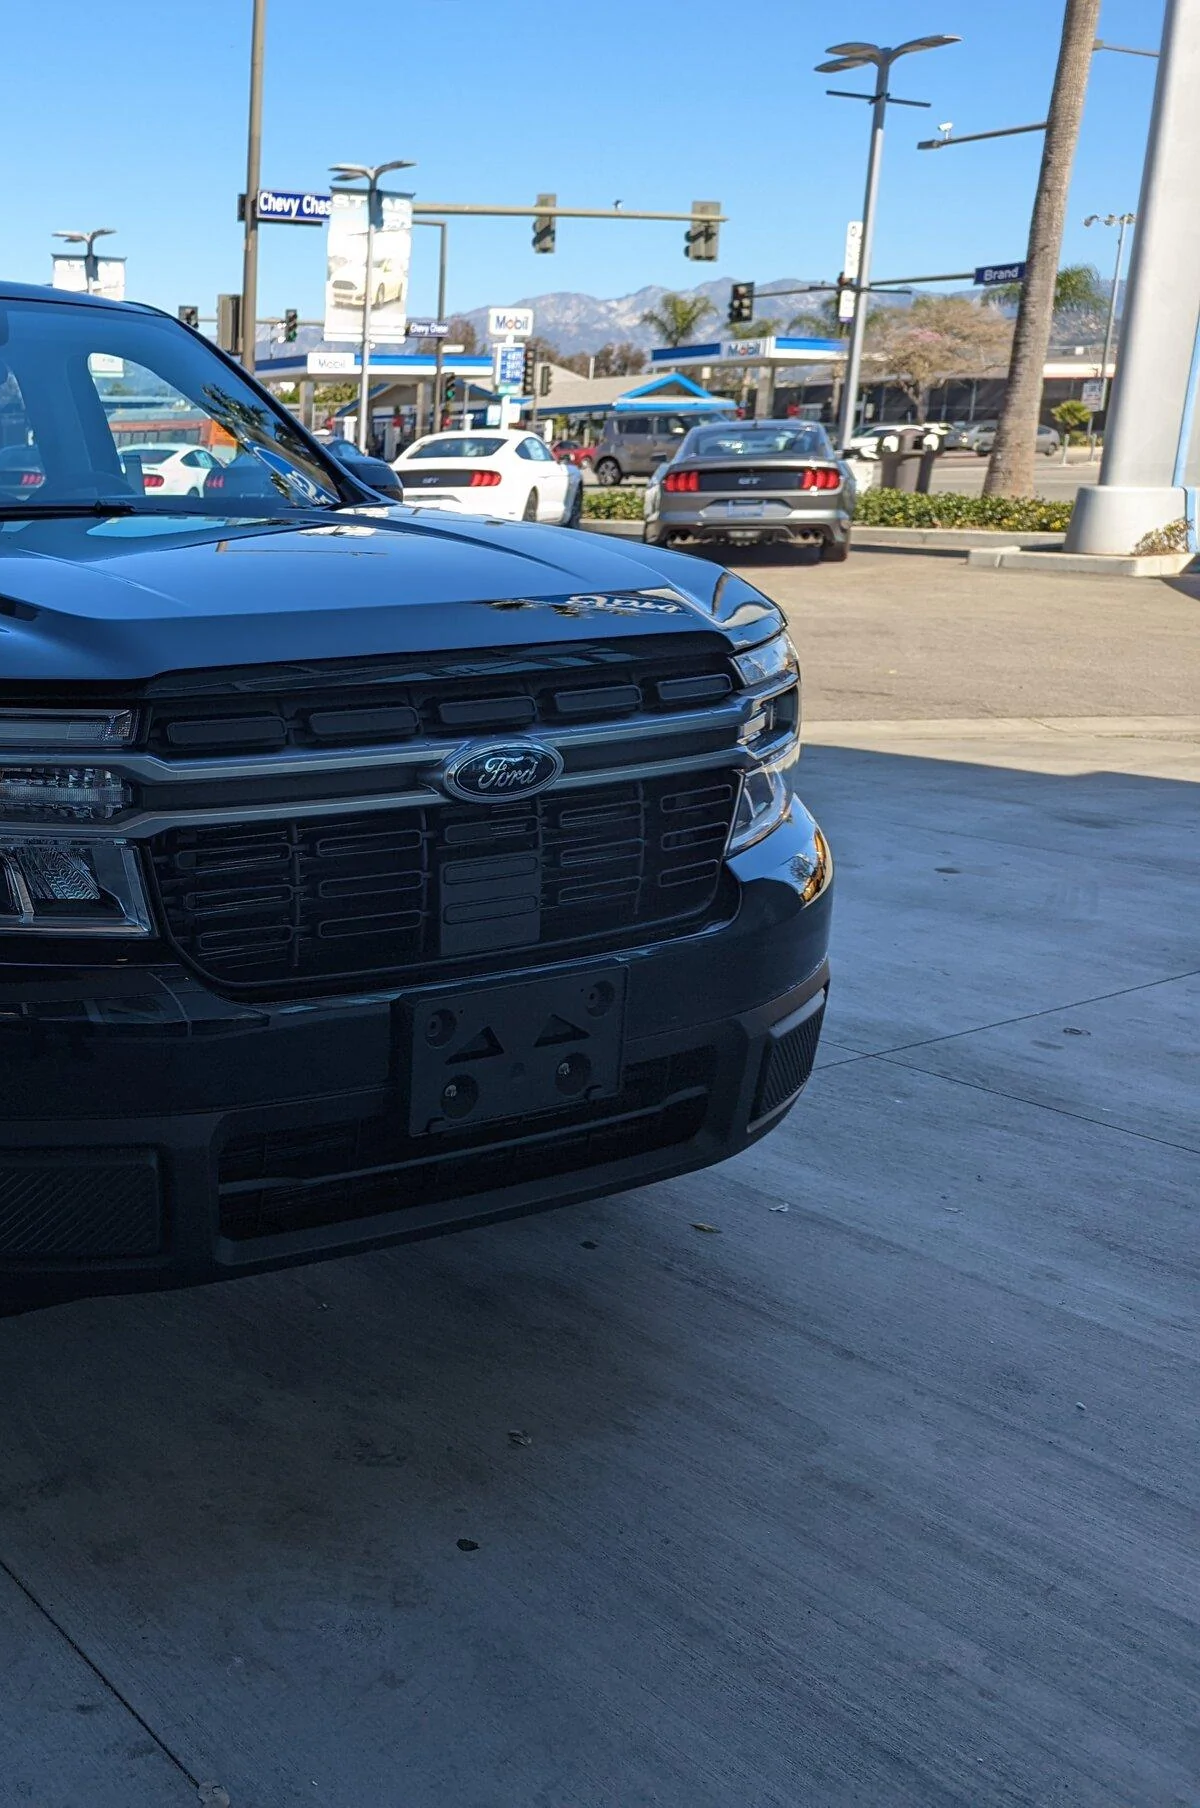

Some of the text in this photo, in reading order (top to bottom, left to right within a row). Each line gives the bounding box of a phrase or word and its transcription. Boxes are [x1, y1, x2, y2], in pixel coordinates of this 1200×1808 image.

[259, 192, 332, 218] Chevy Chas
[983, 266, 1019, 281] Brand
[495, 316, 529, 330] Mobil
[738, 476, 760, 484] GT
[478, 756, 538, 789] Ford
